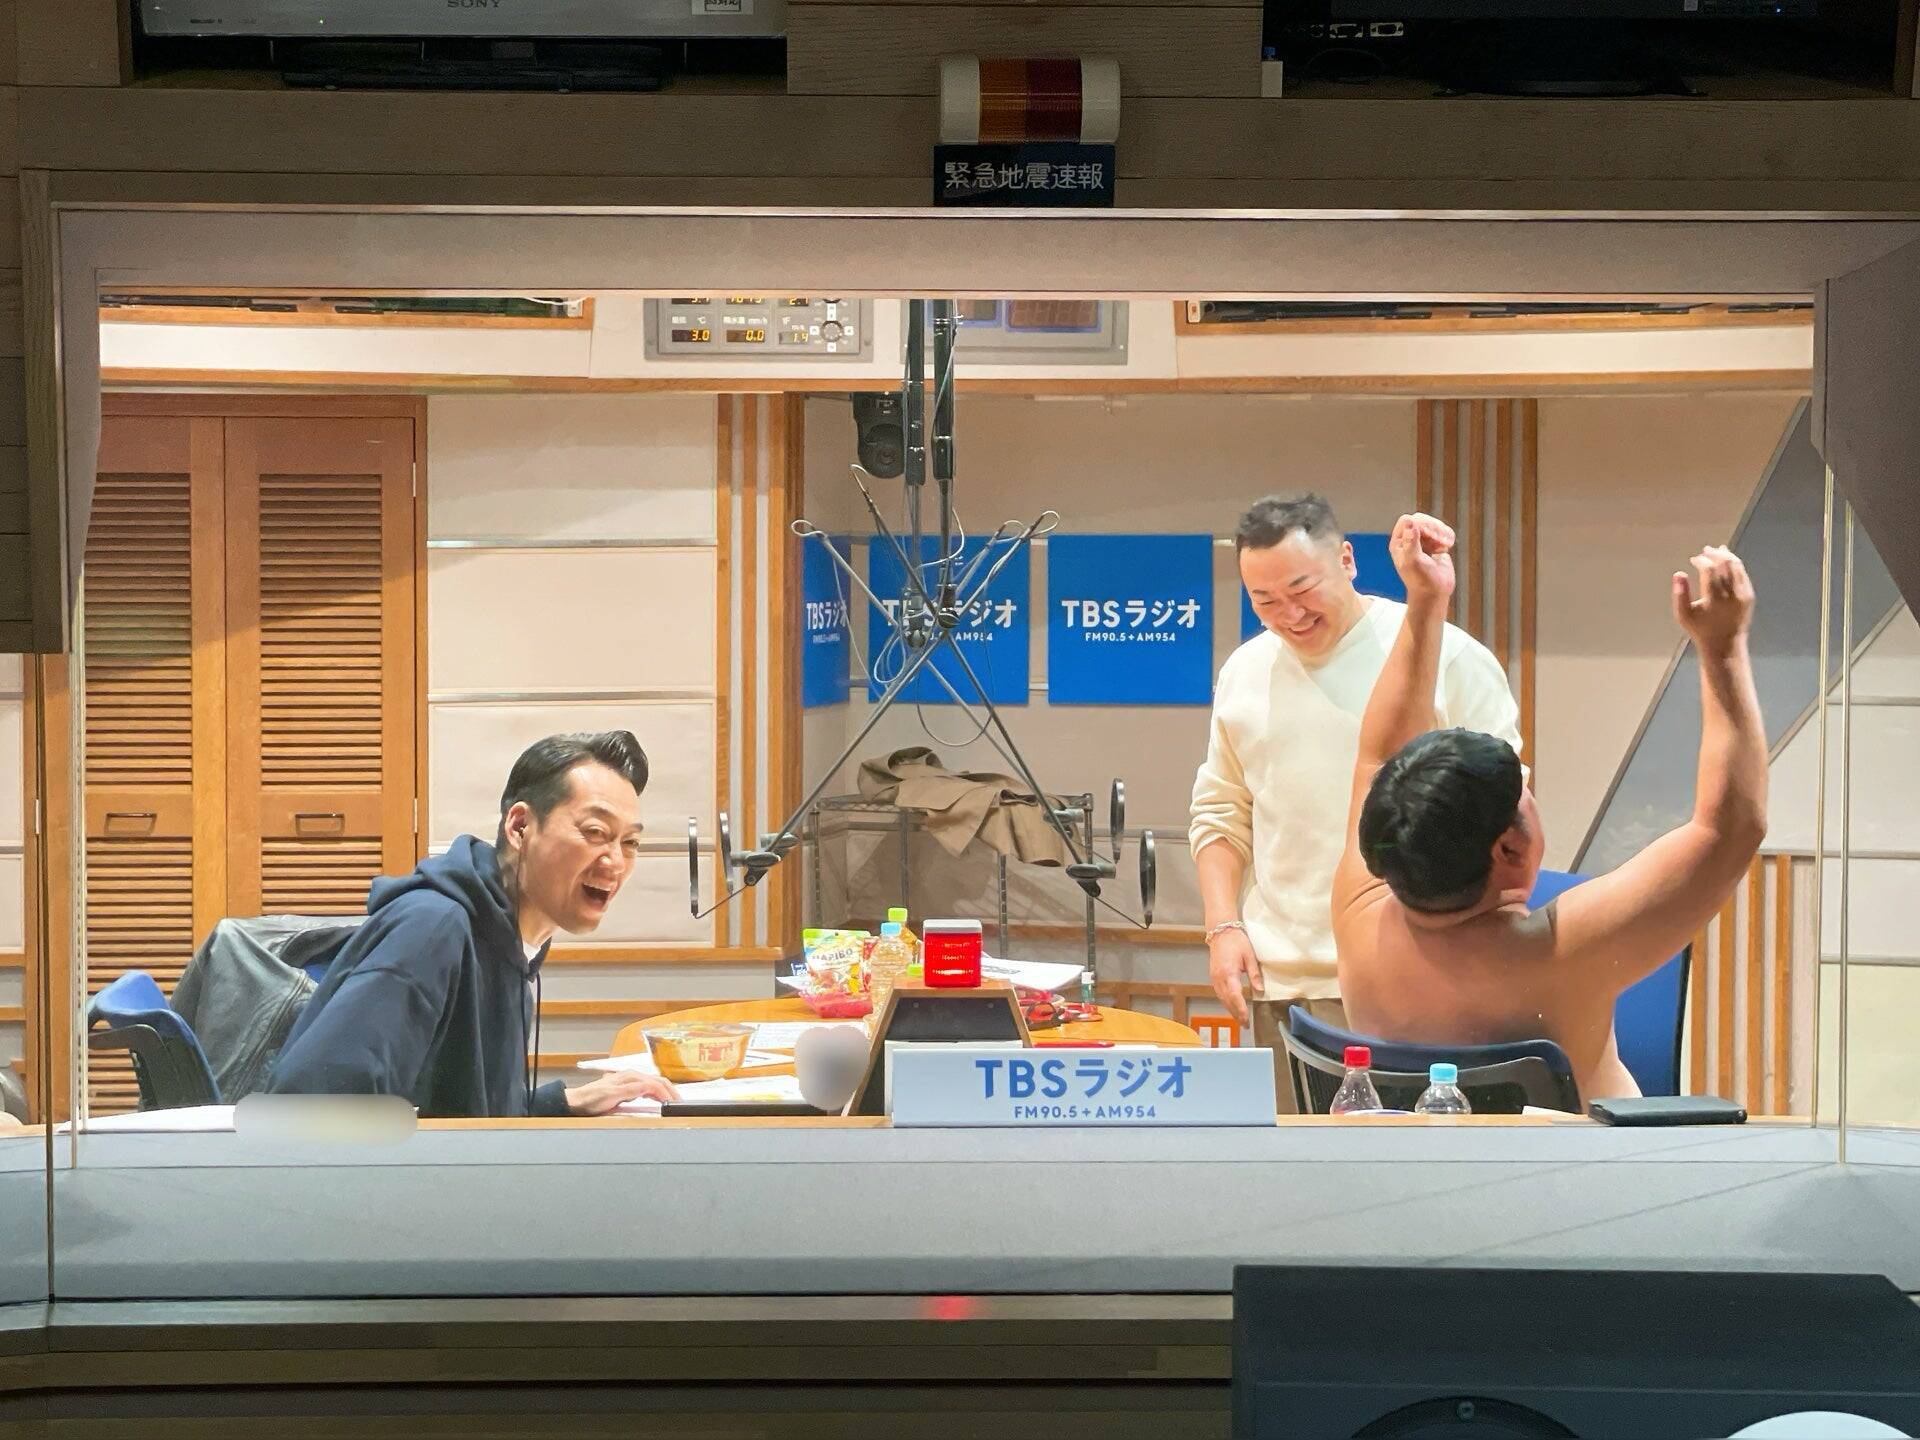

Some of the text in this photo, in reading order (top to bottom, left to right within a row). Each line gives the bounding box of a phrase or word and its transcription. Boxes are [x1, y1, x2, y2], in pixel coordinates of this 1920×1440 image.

[447, 0, 500, 8] SONY
[944, 162, 1104, 190] 緊急地震速報
[691, 329, 710, 341] 3.0
[745, 329, 765, 341] 0.0
[1061, 599, 1201, 629] TBSラジオ
[1085, 632, 1176, 642] FM90.5+AM954
[975, 1056, 1192, 1098] TBSラジオ
[1014, 1105, 1156, 1118] FM90.5+AM954
